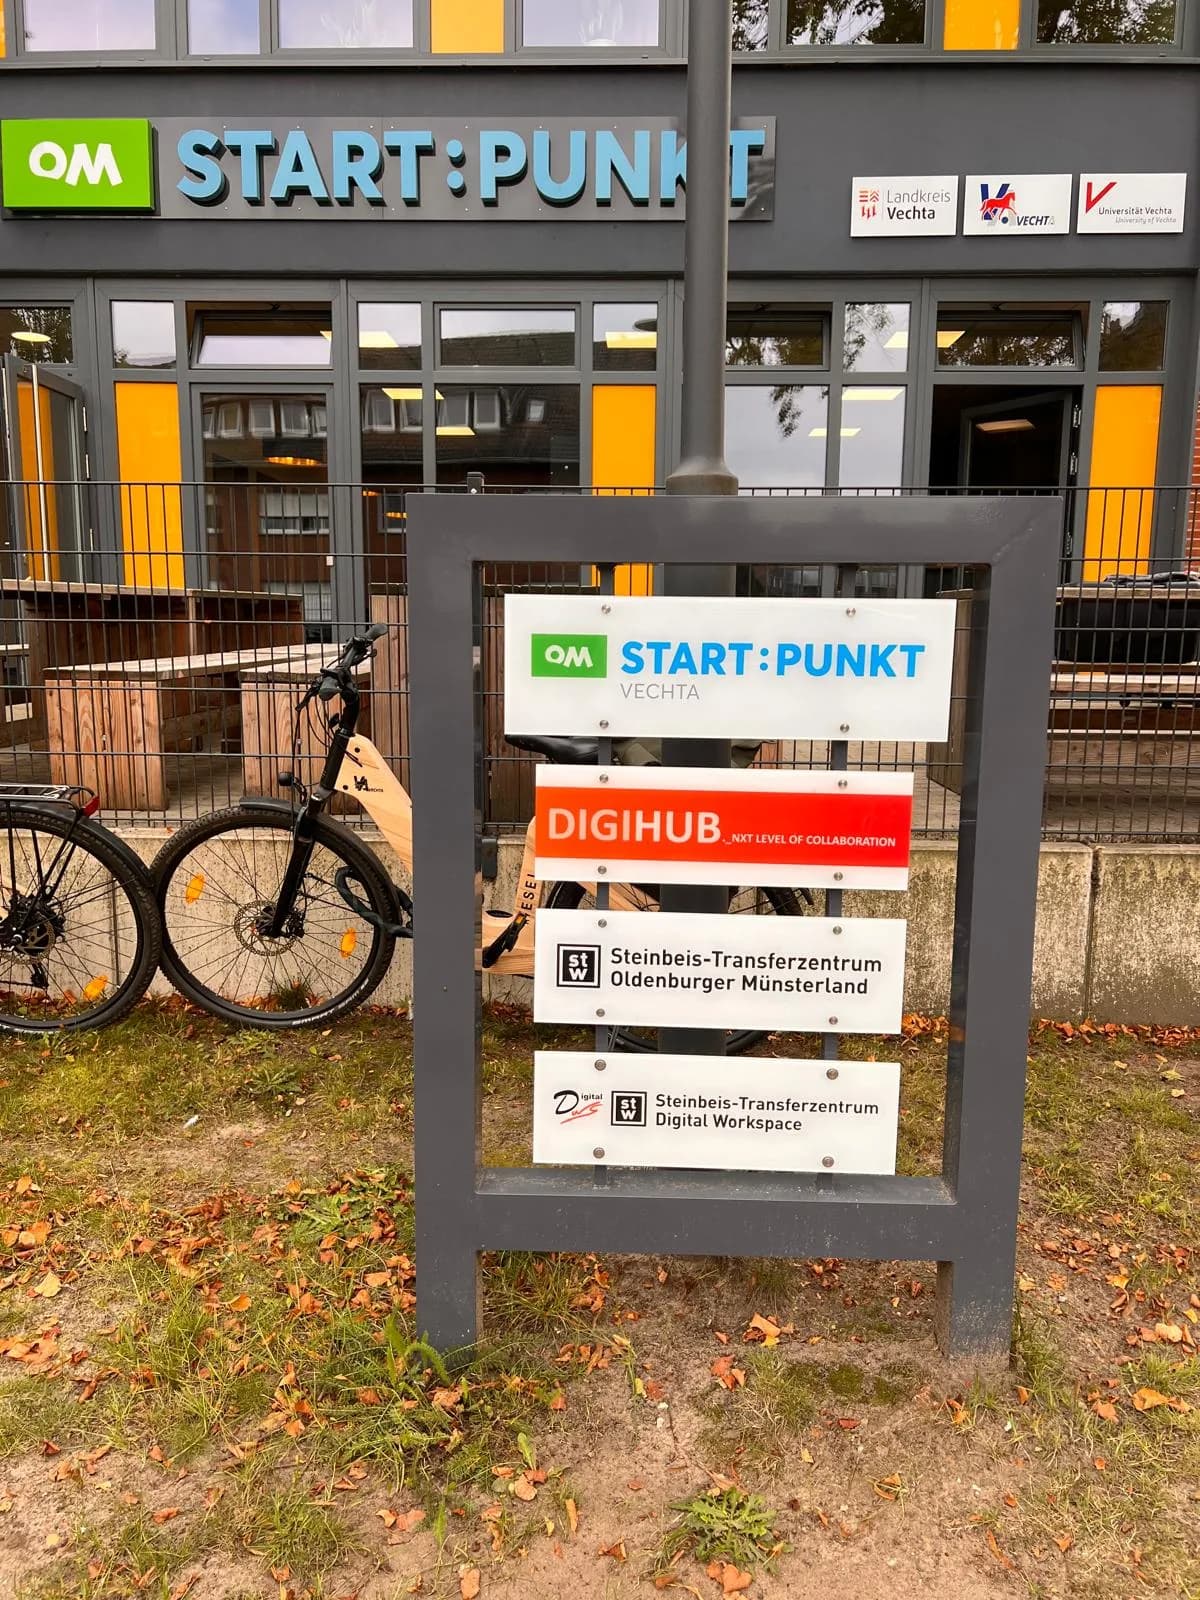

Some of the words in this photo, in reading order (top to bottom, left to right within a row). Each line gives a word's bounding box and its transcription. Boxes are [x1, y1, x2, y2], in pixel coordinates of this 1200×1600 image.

[28, 140, 123, 187] OM
[887, 189, 951, 204] Landkreis
[887, 205, 936, 220] Vechta
[1098, 206, 1143, 215] Universität
[1145, 206, 1172, 215] Vechta
[1115, 216, 1147, 225] University
[1148, 217, 1155, 225] of
[544, 644, 594, 669] OM
[620, 640, 927, 679] START:PUNKT
[620, 683, 700, 700] VECHTA
[548, 808, 721, 844] DIGIHUB
[756, 833, 787, 845] LEVEL
[789, 834, 804, 845] OF
[806, 835, 896, 848] COLLABORATION
[610, 948, 882, 972] Steinbeis-Transferzentrum
[610, 970, 736, 994] Oldenburger
[742, 974, 868, 994] Münsterland
[655, 1093, 879, 1115] Steinbeis-Transferzentrum
[655, 1112, 708, 1130] Digital
[713, 1114, 802, 1133] Workspace
